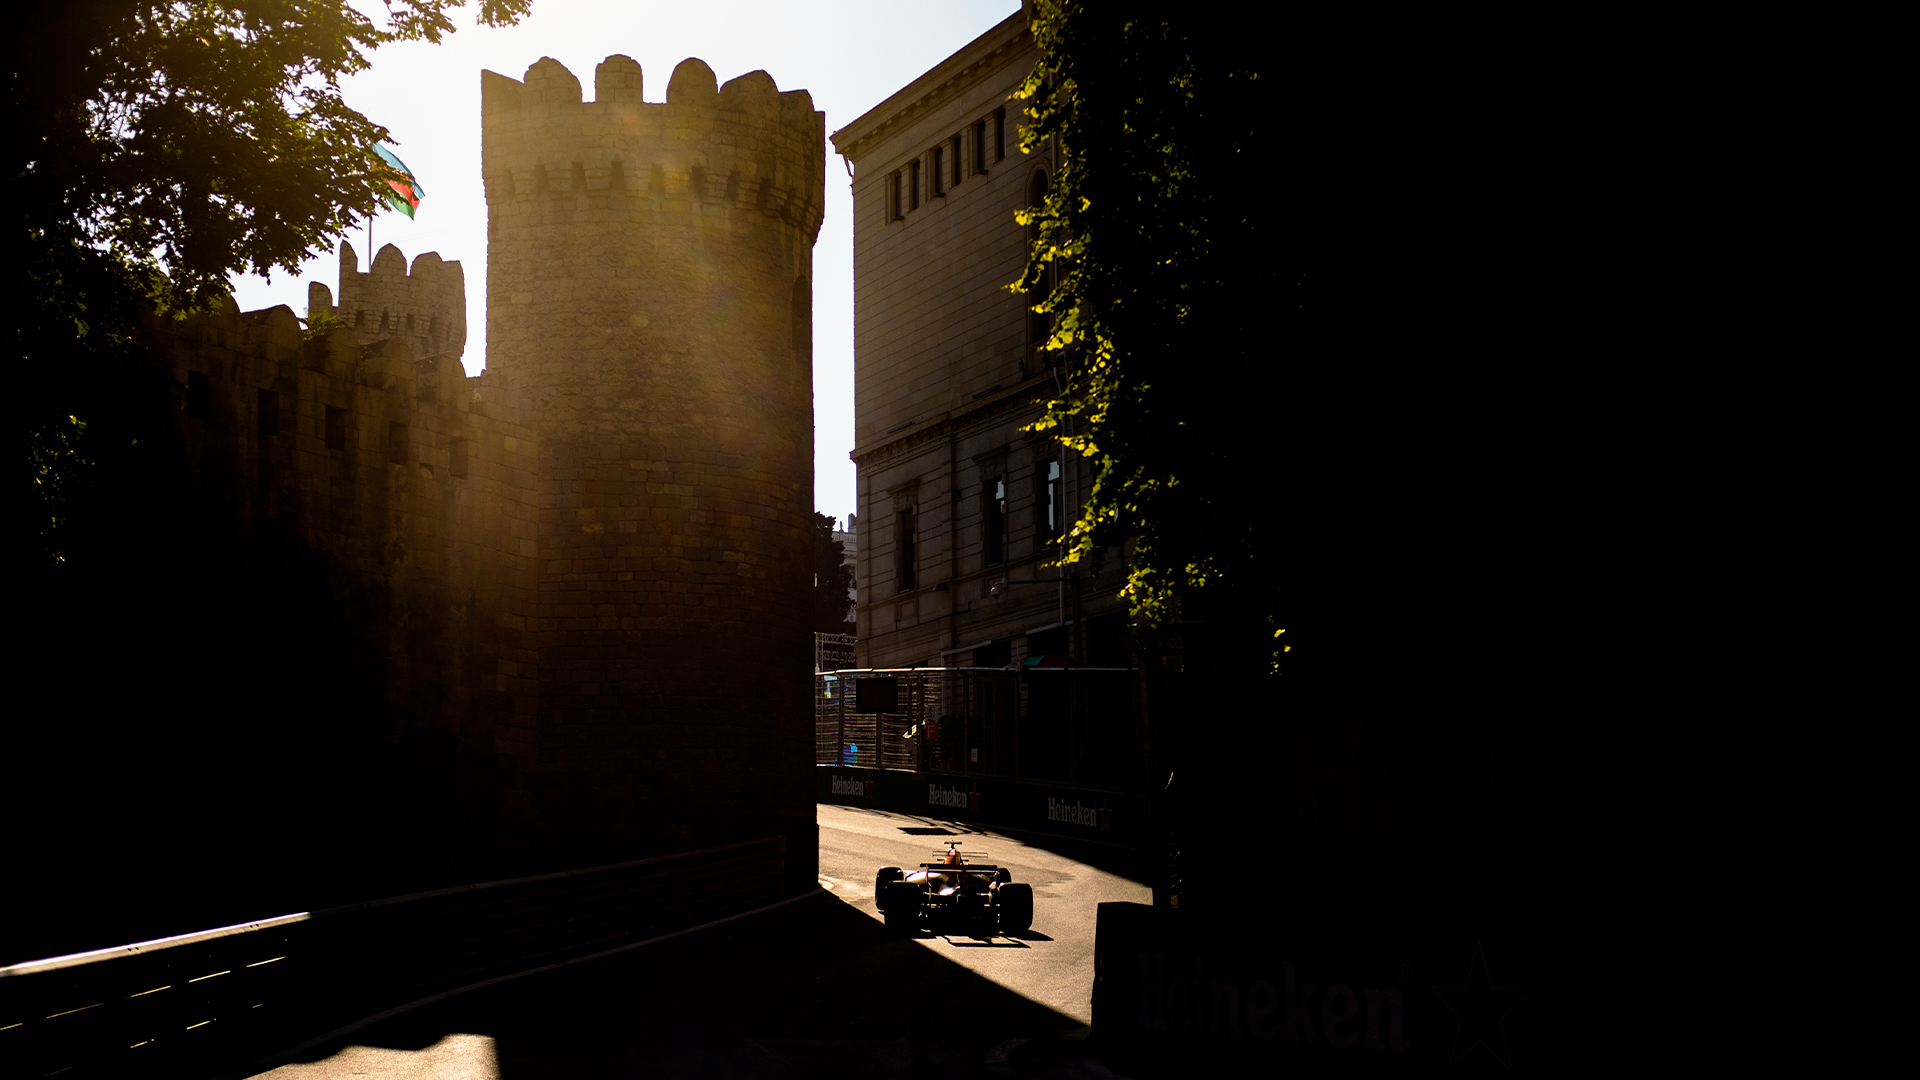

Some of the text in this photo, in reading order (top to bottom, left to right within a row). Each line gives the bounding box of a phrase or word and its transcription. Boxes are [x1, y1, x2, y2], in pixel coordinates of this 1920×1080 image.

[831, 774, 864, 797] Heineken
[928, 783, 968, 809] Heineken
[1047, 796, 1097, 827] Heineken
[1136, 952, 1411, 1053] Heineken
